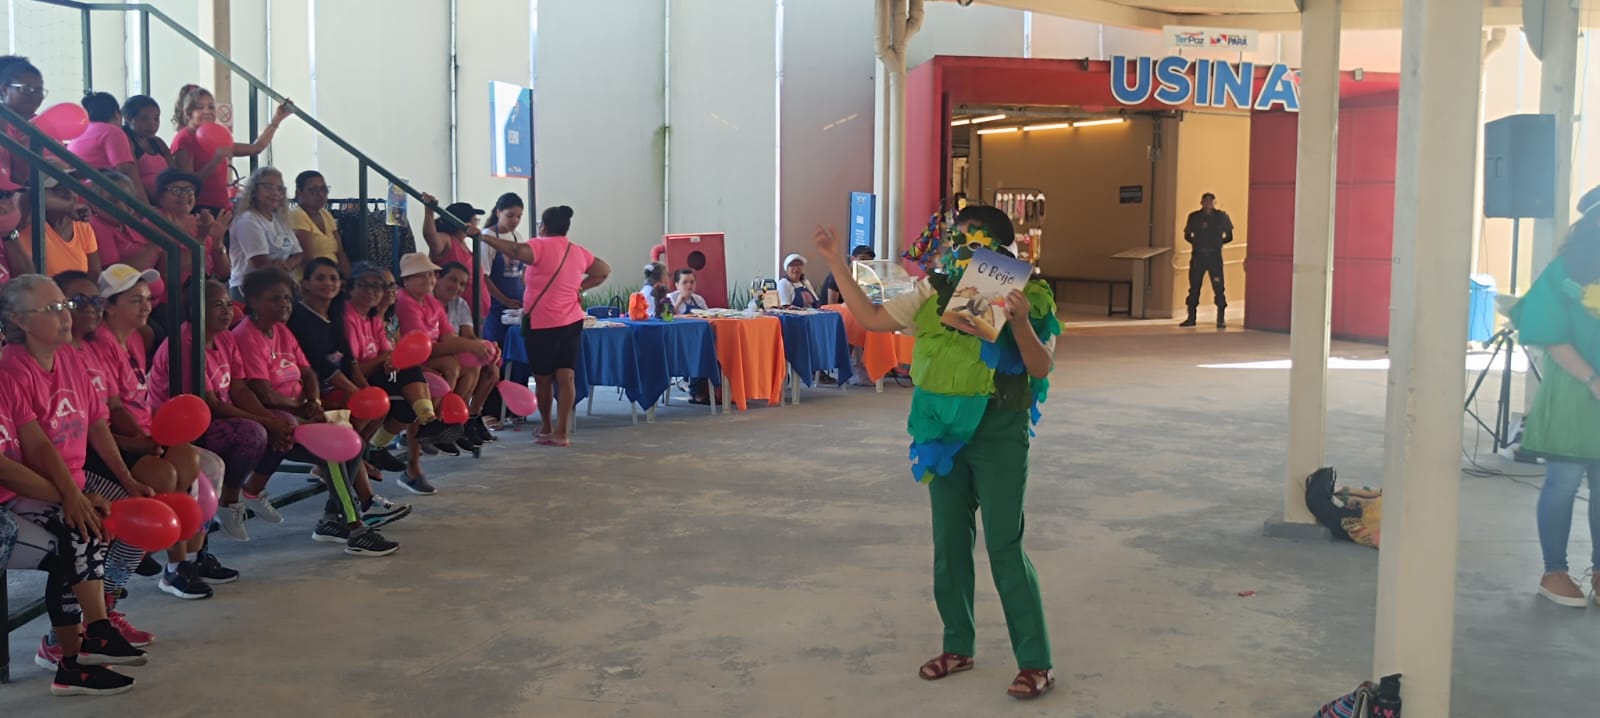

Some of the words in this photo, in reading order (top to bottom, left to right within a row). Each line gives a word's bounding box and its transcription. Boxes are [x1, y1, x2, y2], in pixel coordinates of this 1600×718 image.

[1110, 54, 1300, 112] USINA
[977, 262, 988, 274] O
[988, 265, 1015, 286] Beijo
